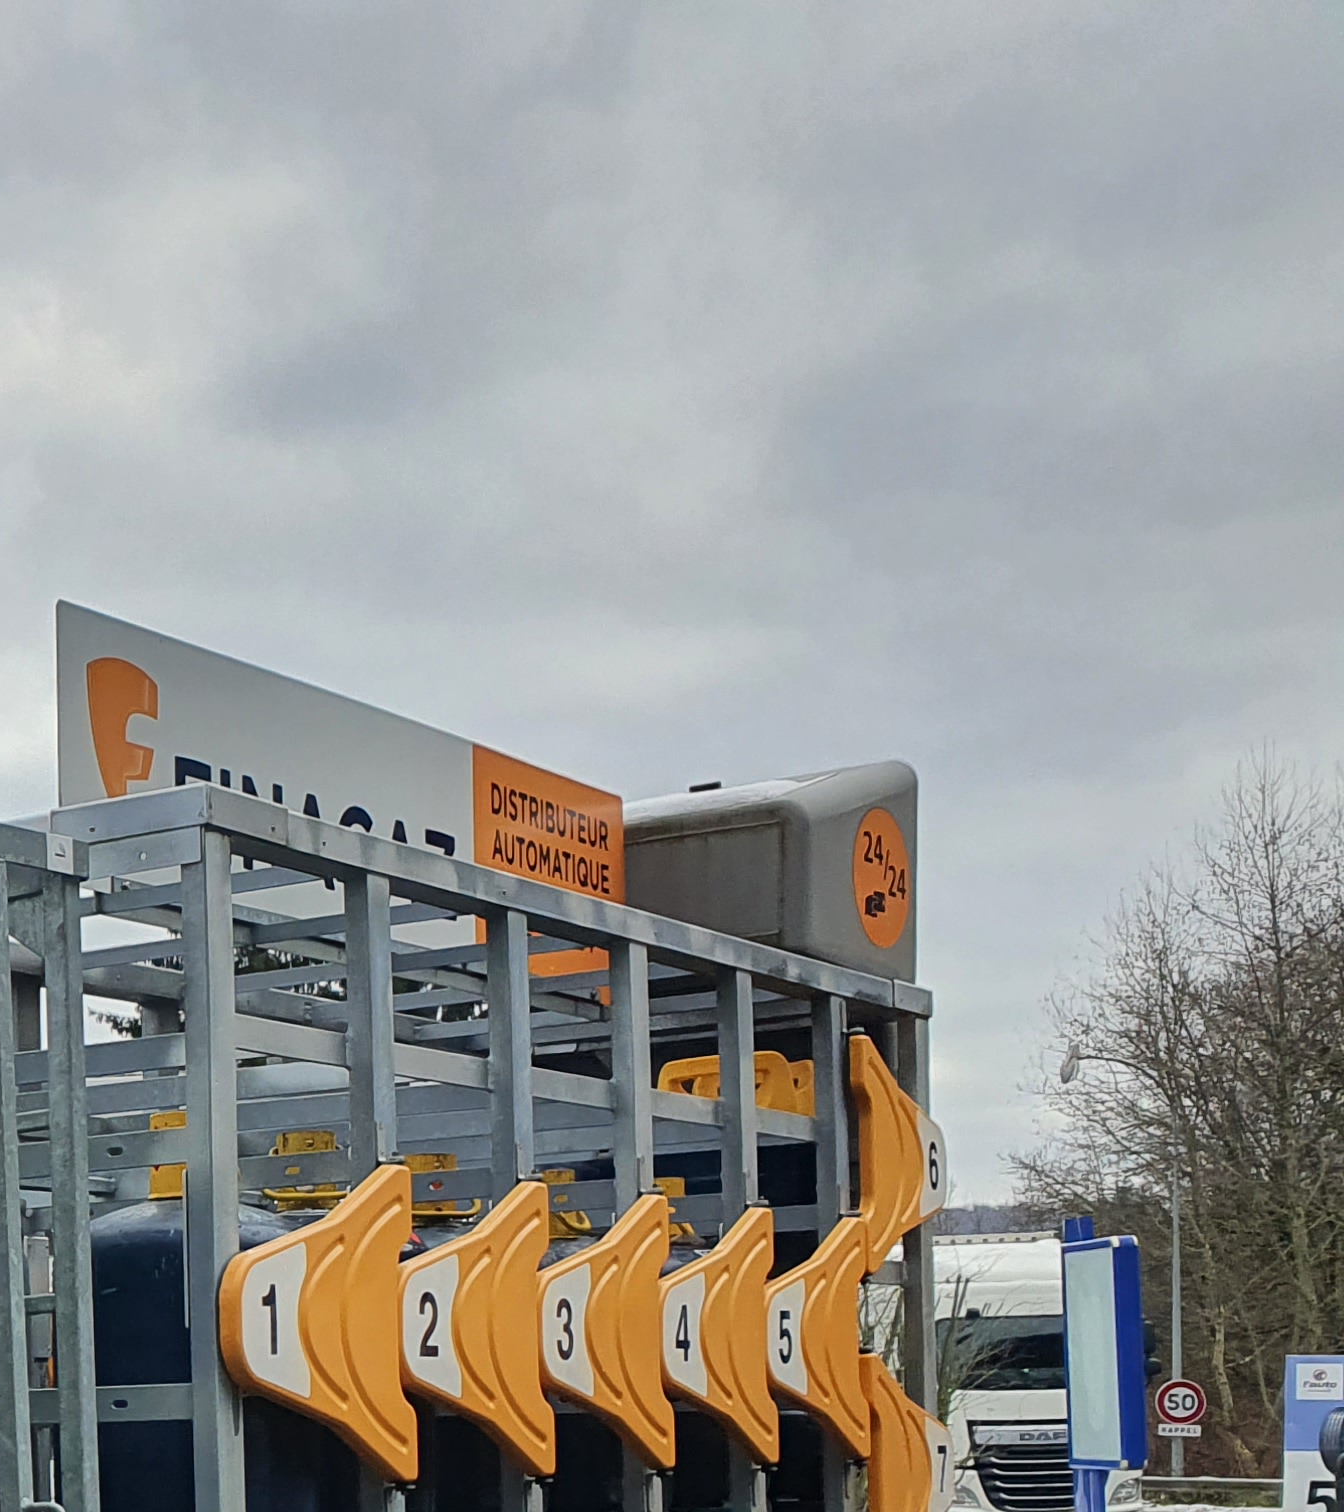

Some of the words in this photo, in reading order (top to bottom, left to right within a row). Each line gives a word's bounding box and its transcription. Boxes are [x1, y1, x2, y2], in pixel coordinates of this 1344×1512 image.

[490, 781, 609, 851] DISTRIBUTEUR
[491, 829, 610, 895] AUTOMATIQUE
[929, 1141, 939, 1190] 6
[261, 1283, 279, 1355] 1
[419, 1291, 440, 1357] 2
[556, 1298, 574, 1361] 3
[675, 1303, 691, 1362] 4
[778, 1310, 793, 1364] 5
[1167, 1393, 1195, 1411] 50
[1019, 1431, 1066, 1441] DAF
[937, 1446, 947, 1493] 7
